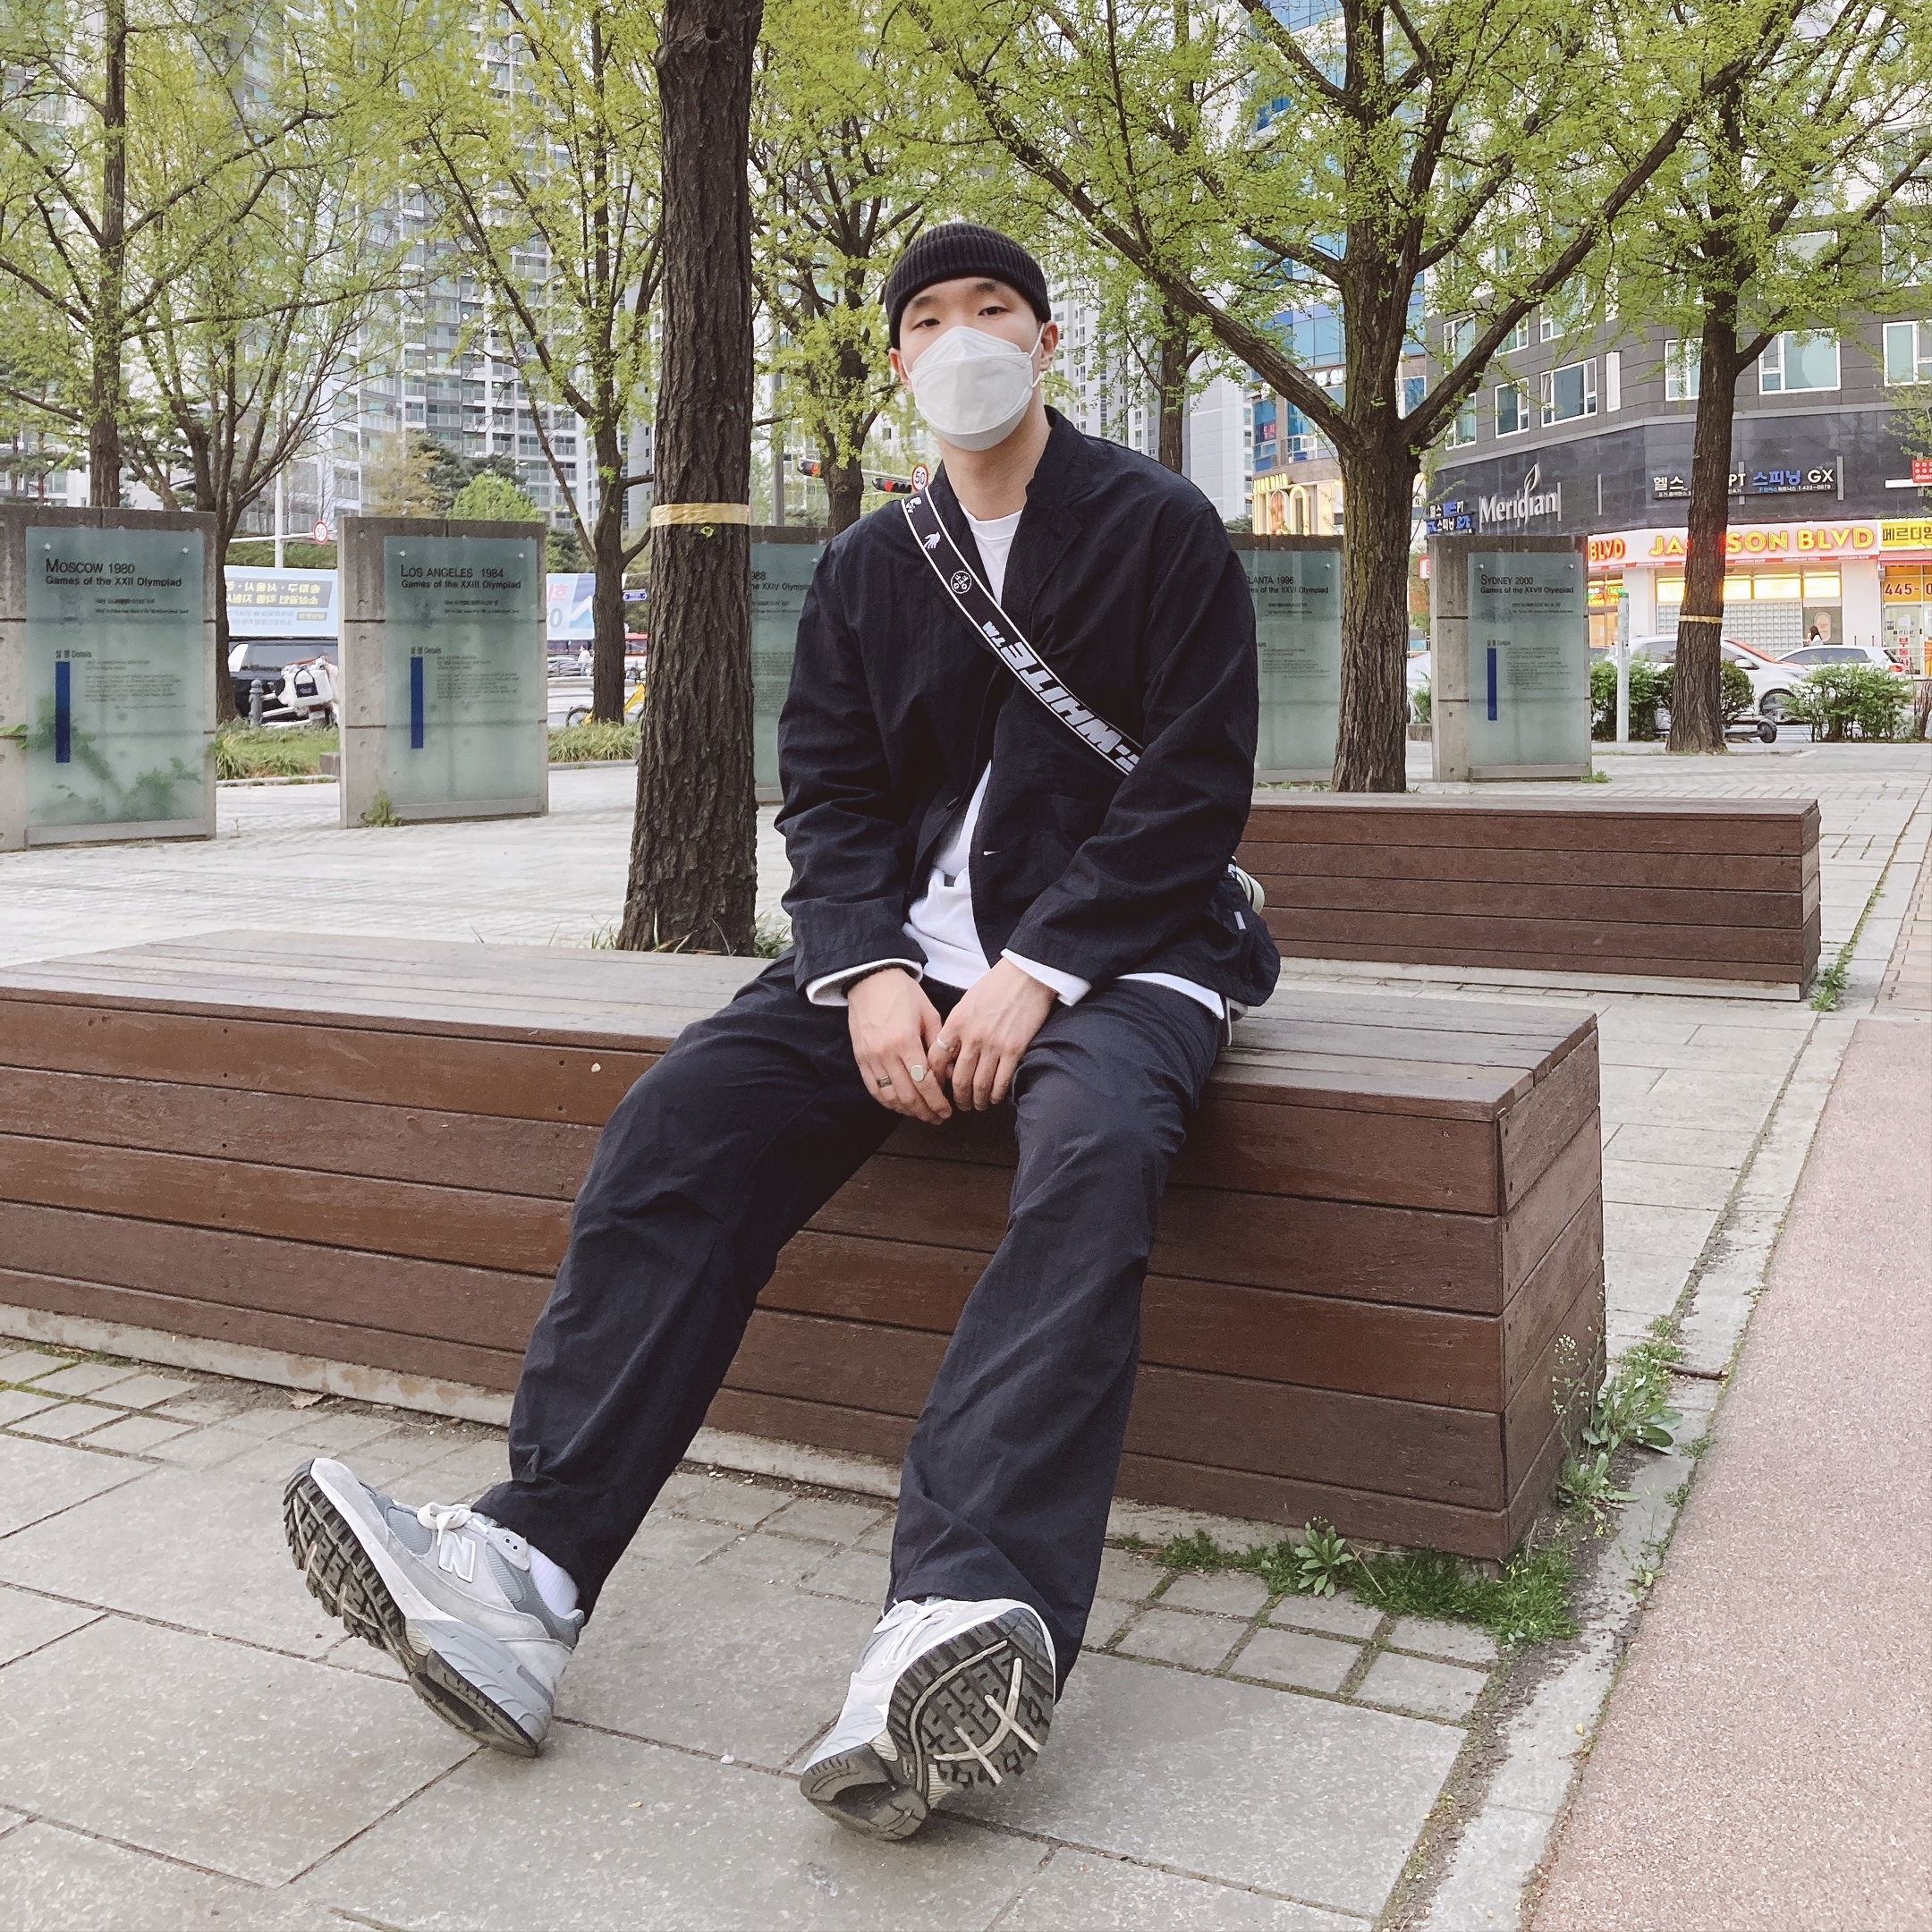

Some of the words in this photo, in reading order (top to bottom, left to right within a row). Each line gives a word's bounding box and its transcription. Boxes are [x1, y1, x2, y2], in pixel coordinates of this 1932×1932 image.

[915, 470, 925, 484] 50
[1653, 476, 1684, 491] 헬스
[1728, 473, 1746, 487] PT
[1753, 470, 1801, 486] 스피닝
[1808, 469, 1834, 483] GX
[1479, 479, 1560, 528] Meridian
[317, 528, 326, 538] 50
[1797, 527, 1874, 550] BLVD
[1589, 538, 1625, 560] BLVD
[108, 563, 135, 574] 1980
[427, 568, 473, 578] ANGELES
[481, 568, 504, 578] 1984
[751, 571, 766, 580] 988
[1276, 576, 1294, 584] 1996
[1515, 577, 1533, 585] 2000
[46, 576, 80, 586] Games
[83, 576, 93, 586] of
[96, 577, 111, 586] the
[114, 577, 134, 586] XXII
[137, 577, 182, 588] Olympiad
[402, 580, 431, 589] Games
[434, 580, 442, 589] of
[445, 580, 458, 589] the
[482, 580, 521, 589] Olympiad
[438, 1532, 476, 1583] N
